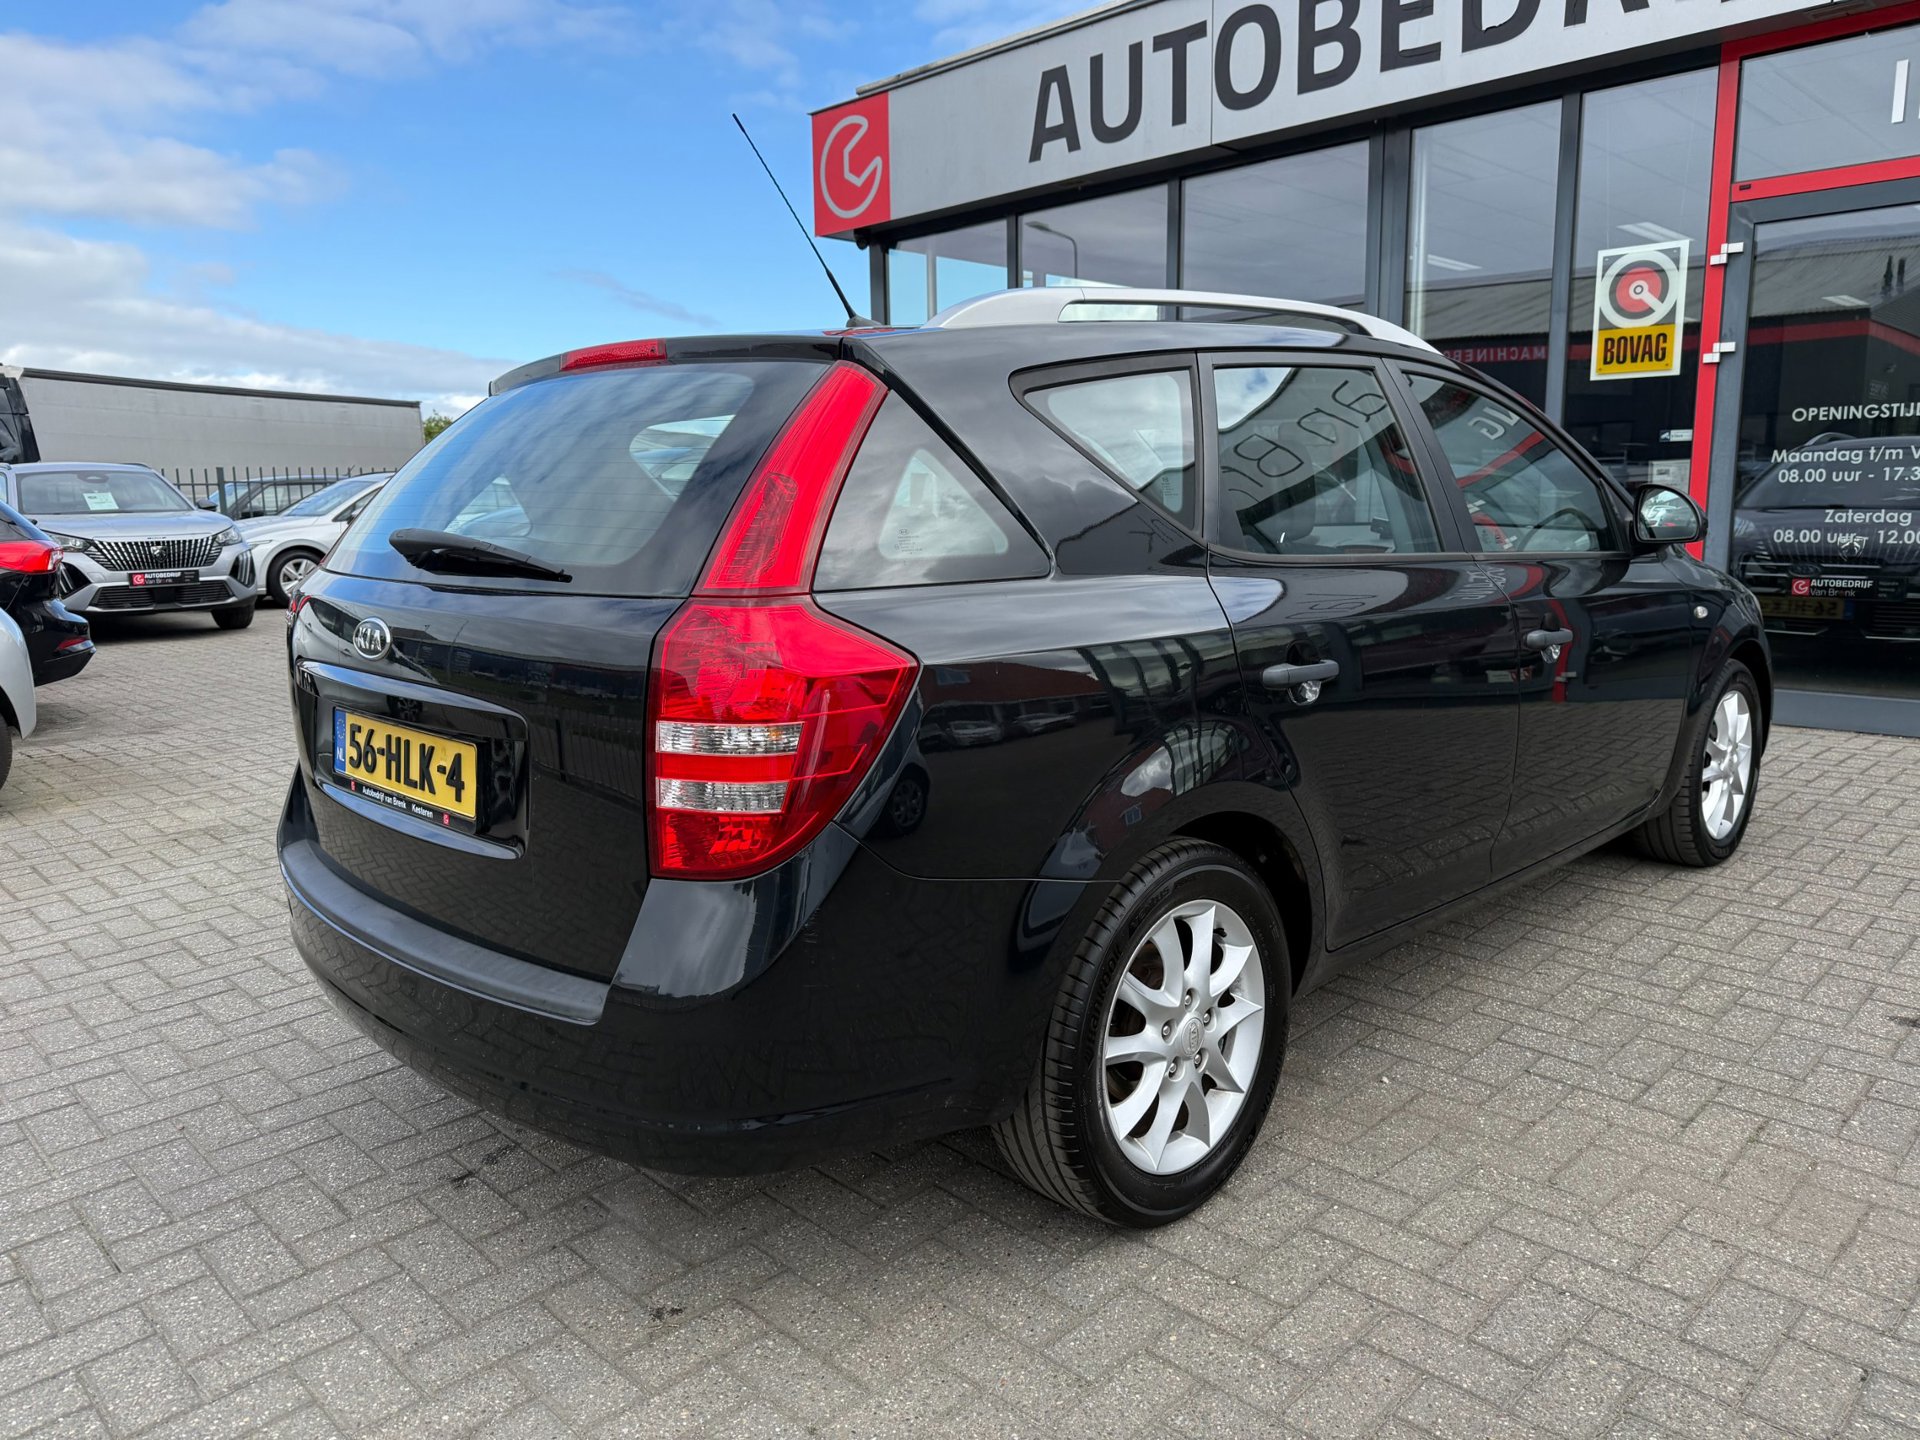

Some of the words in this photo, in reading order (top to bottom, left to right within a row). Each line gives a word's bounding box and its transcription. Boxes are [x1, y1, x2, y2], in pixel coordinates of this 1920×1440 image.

[1029, 0, 1649, 162] AUTOBE
[1603, 333, 1668, 366] BOVAG
[1771, 448, 1863, 464] Maandag
[1869, 445, 1903, 462] t/m
[1778, 468, 1826, 483] 08.00
[1832, 470, 1862, 482] uur
[1883, 466, 1920, 481] 17.3
[1824, 509, 1912, 527] Zaterdag
[1773, 529, 1821, 543] 08.00
[1827, 531, 1856, 543] uur
[1810, 579, 1874, 589] AUTOBEDRIJF
[1810, 588, 1826, 596] Van
[356, 627, 382, 651] KIA
[336, 746, 345, 762] NL
[348, 723, 465, 803] 56-HLK-4
[362, 786, 385, 802] Autobedrijf
[385, 795, 393, 804] van
[393, 796, 407, 809] Brenk
[411, 804, 434, 819] Kesteren
